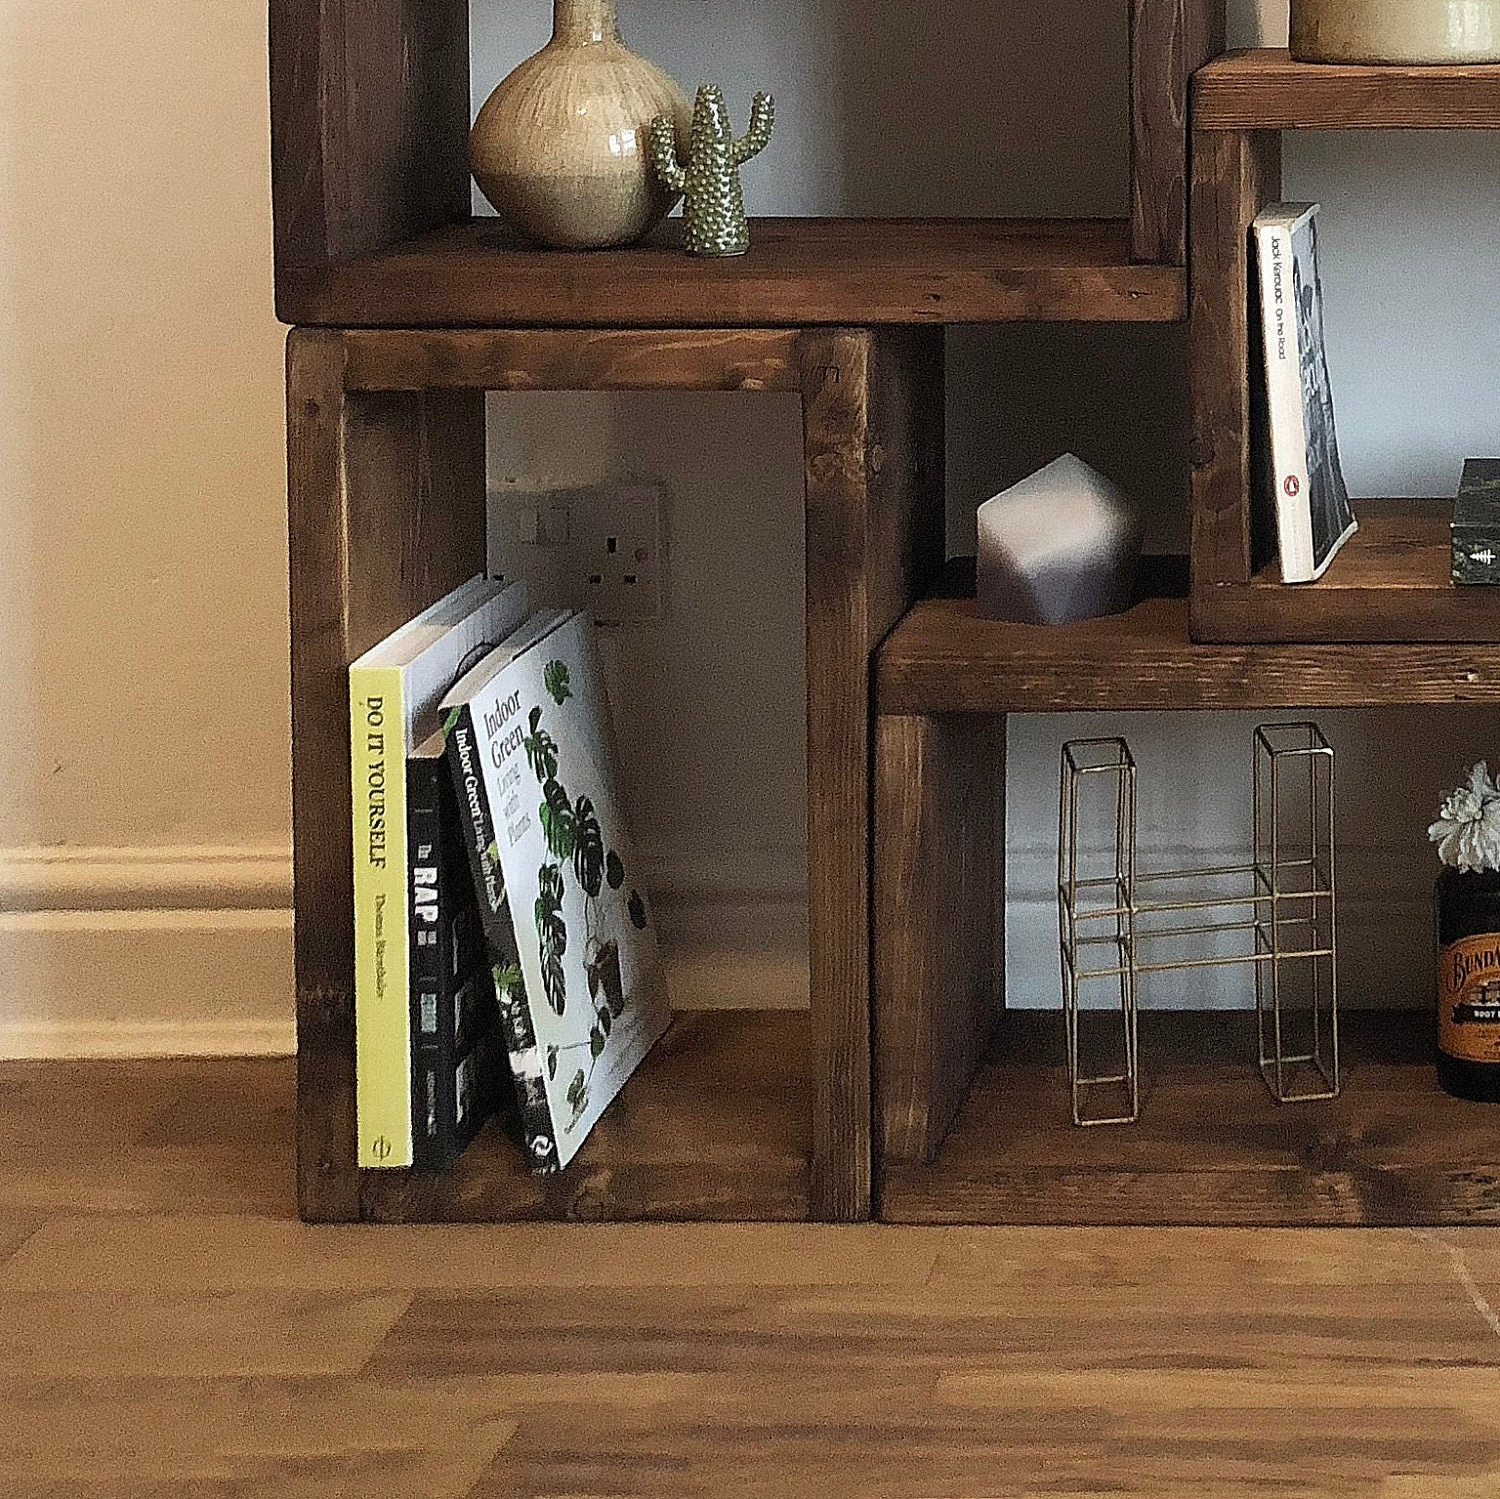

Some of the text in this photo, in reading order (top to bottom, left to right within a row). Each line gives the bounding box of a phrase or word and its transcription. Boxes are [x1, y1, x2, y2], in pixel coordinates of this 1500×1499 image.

[1272, 236, 1281, 259] Jack
[1273, 262, 1283, 304] Kerouac
[1275, 309, 1283, 321] On
[1278, 337, 1286, 359] Road
[367, 697, 383, 726] DO
[483, 689, 522, 741] Indoor
[368, 733, 384, 755] IT
[490, 724, 524, 769] Green
[455, 728, 473, 776] Indoor
[464, 775, 482, 817] Green
[368, 760, 386, 869] YOURSELF
[414, 867, 438, 922] RAP
